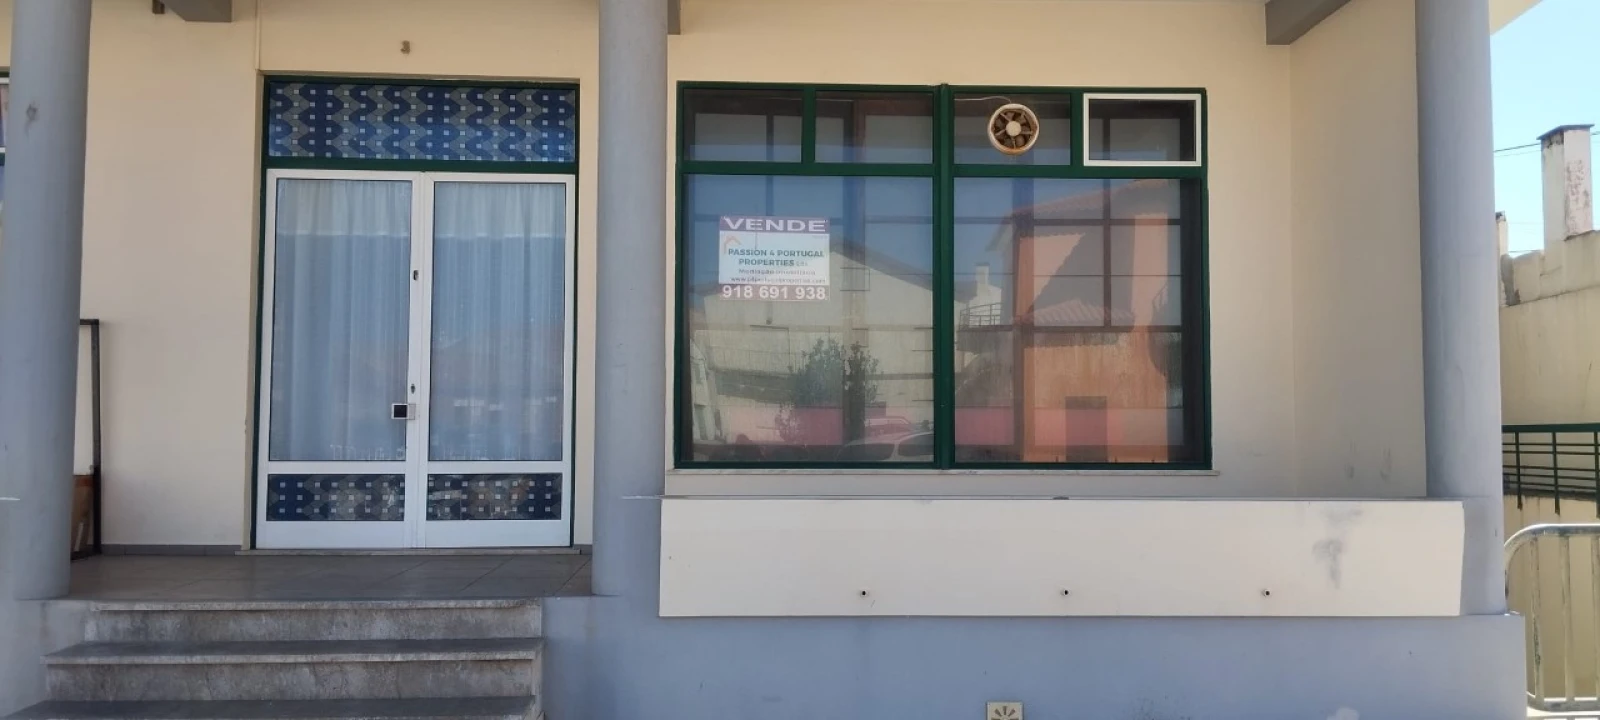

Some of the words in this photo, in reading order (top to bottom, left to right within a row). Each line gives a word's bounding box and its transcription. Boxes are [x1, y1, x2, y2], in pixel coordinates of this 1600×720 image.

[723, 217, 827, 232] VENDE
[728, 248, 767, 257] PASSION
[777, 249, 825, 258] PORTUGAL
[738, 259, 795, 267] PROPERTIES
[722, 285, 753, 298] 918
[759, 286, 788, 299] 691
[795, 286, 826, 300] 938
